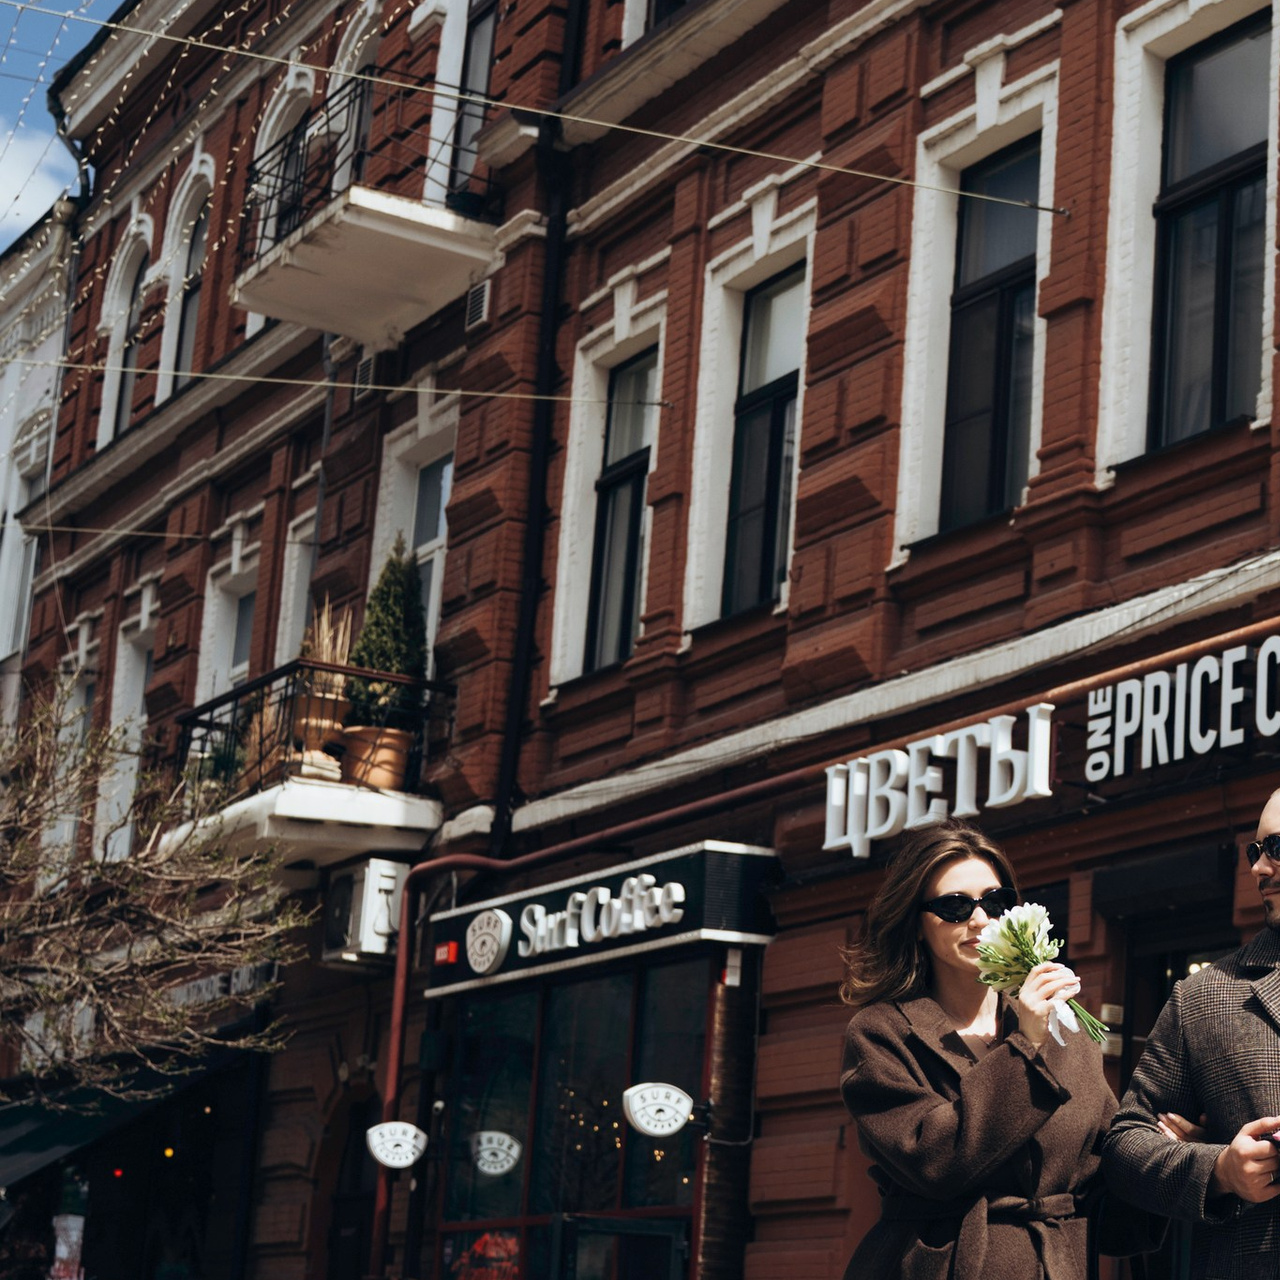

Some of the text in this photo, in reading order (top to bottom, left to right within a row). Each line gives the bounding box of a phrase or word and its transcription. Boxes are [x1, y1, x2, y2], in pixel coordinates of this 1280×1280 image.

[822, 702, 1056, 858] ЦВЕТЫ
[1084, 684, 1113, 782] ONE
[1113, 645, 1254, 777] PRICE
[640, 1090, 682, 1105] SURF
